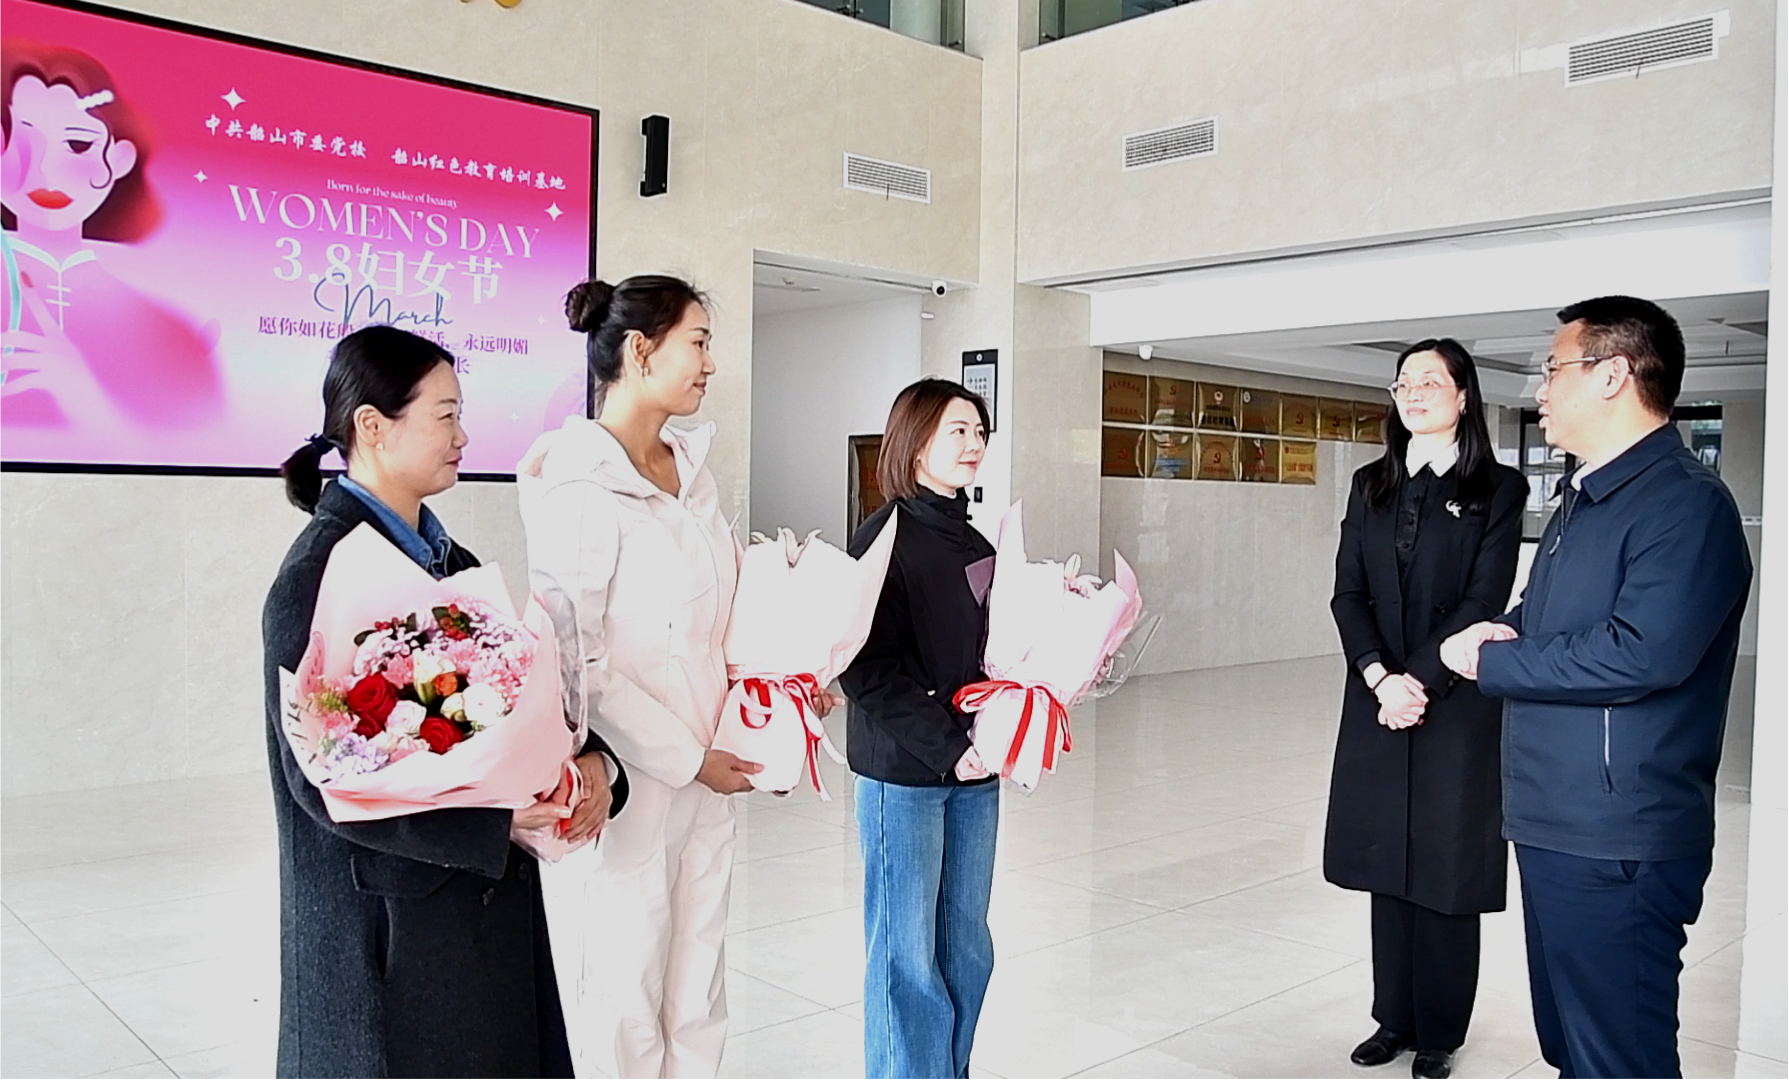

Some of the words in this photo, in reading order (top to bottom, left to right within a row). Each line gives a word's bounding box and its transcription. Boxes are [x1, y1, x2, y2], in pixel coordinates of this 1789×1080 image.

[205, 113, 366, 159] 中共韶山市委党校
[391, 148, 566, 190] 韶山红色教育培训基地
[228, 184, 448, 247] WOMEN'S
[459, 217, 540, 258] DAY
[327, 179, 353, 192] Born
[356, 183, 371, 194] for
[373, 186, 389, 198] the
[391, 190, 414, 201] sake
[415, 193, 426, 203] of
[427, 194, 457, 210] beauty
[273, 237, 503, 304] 3.8妇女节
[314, 272, 453, 327] March
